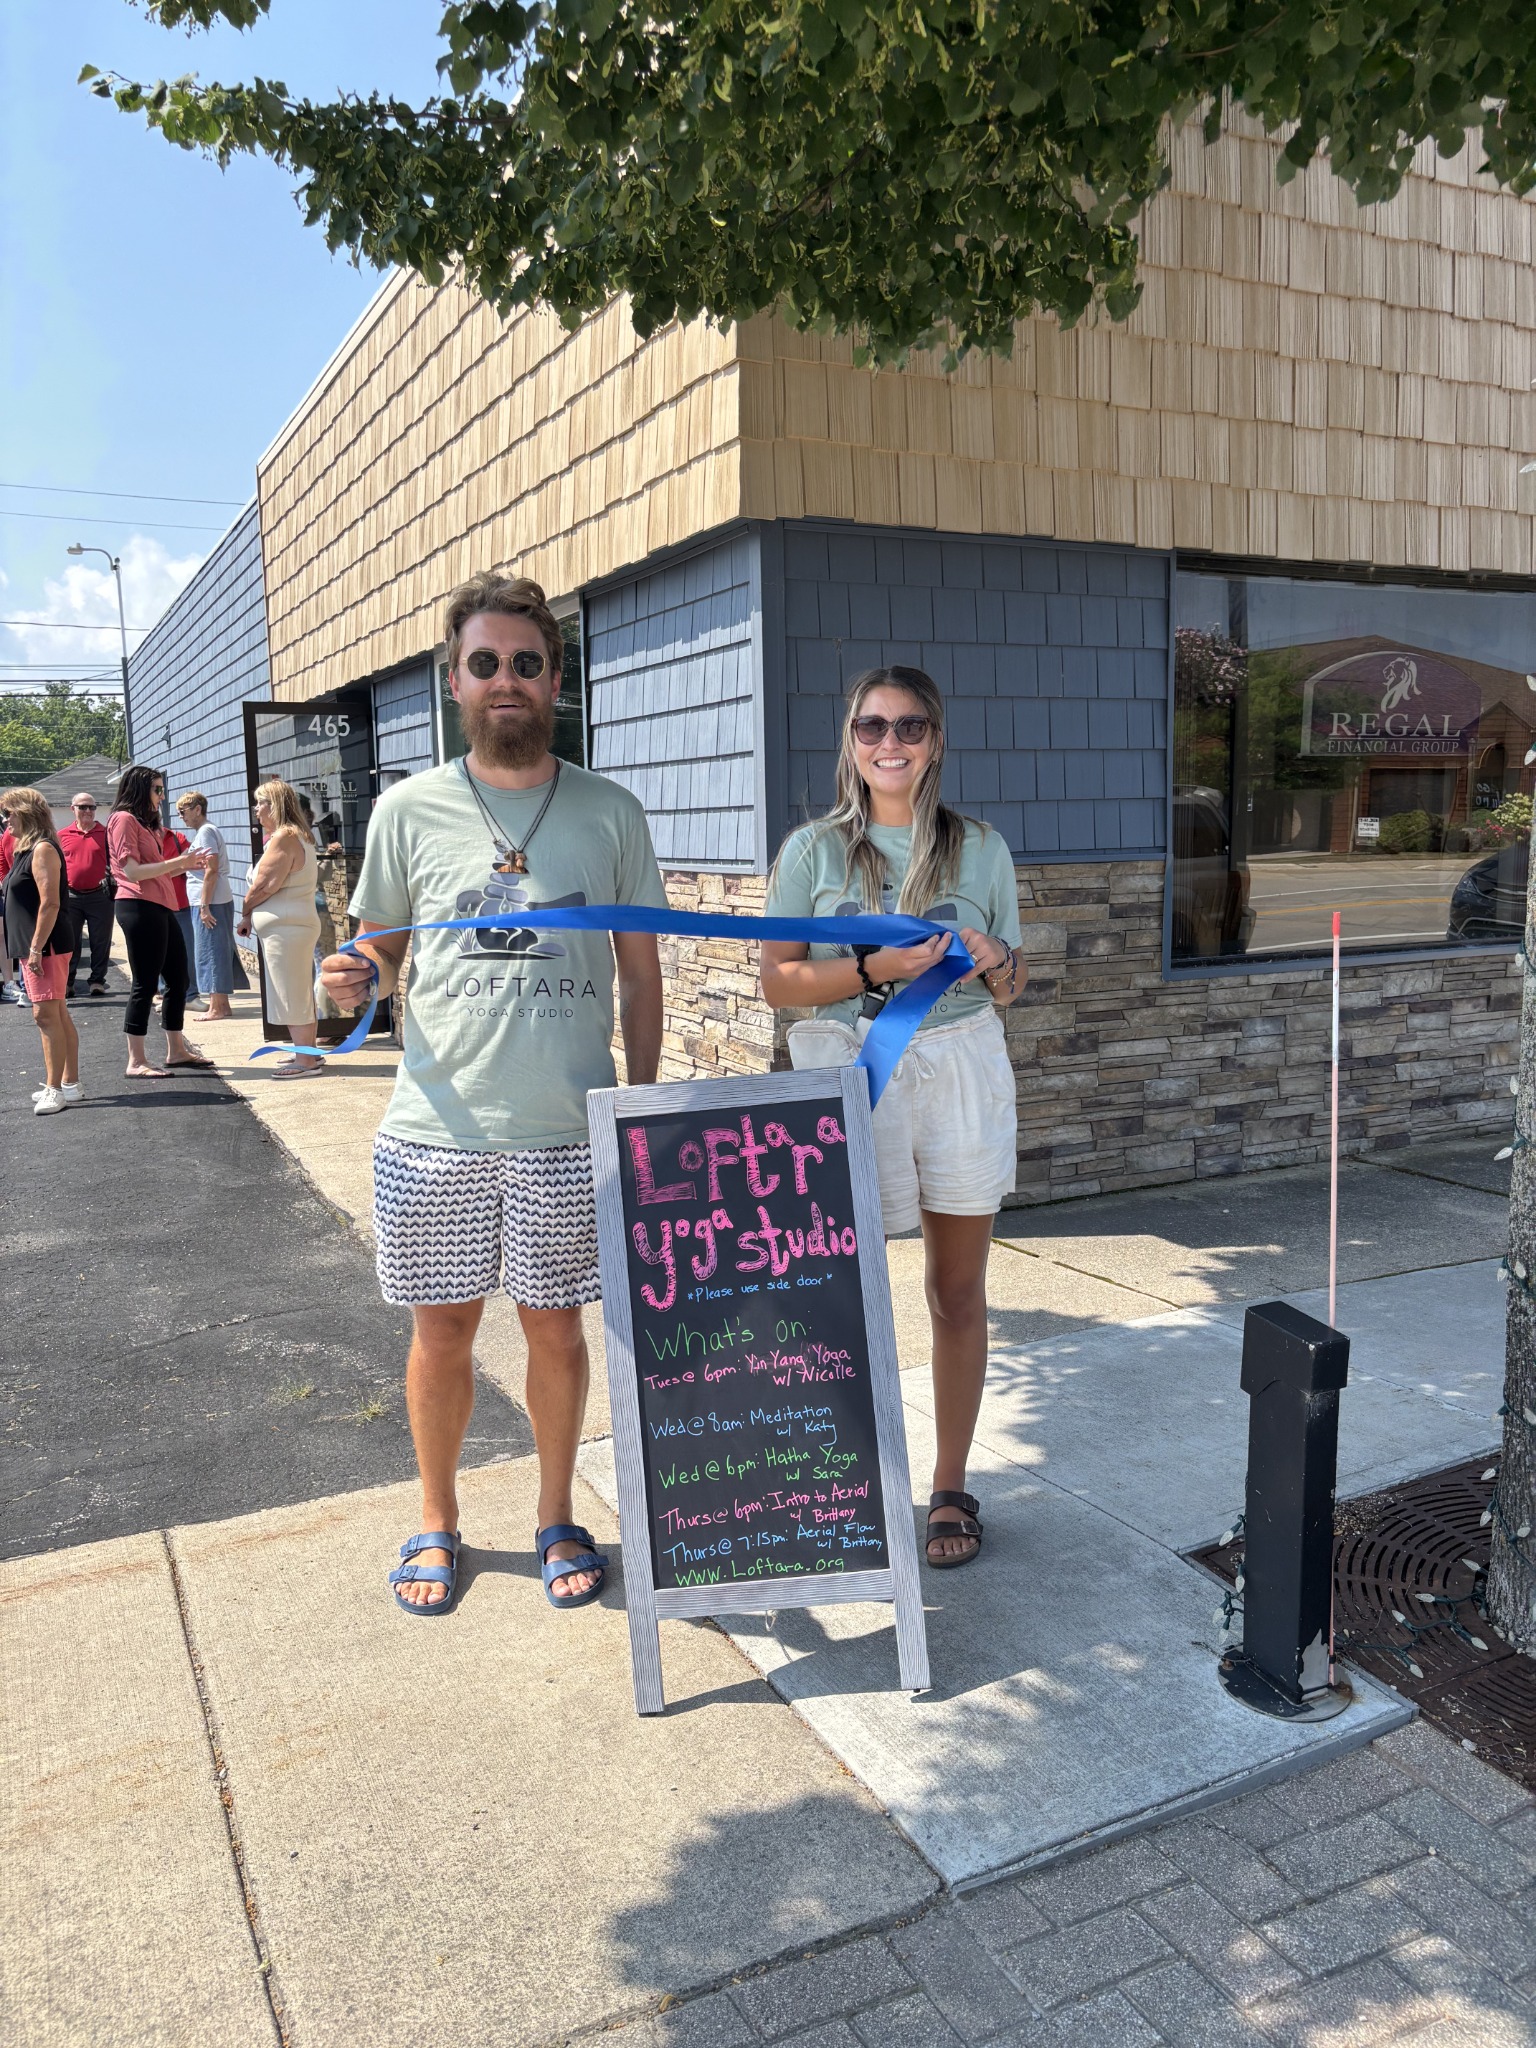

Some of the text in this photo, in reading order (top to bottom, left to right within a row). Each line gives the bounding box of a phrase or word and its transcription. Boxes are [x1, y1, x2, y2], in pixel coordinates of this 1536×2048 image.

[308, 714, 350, 737] 465
[1329, 712, 1461, 737] REGAL
[1328, 740, 1459, 753] FINANCIAL GROUP
[309, 781, 357, 792] REAL
[446, 977, 597, 998] LOFTARA
[467, 1008, 574, 1018] YOGA STUDIO
[735, 1201, 857, 1277] studio
[741, 1282, 760, 1294] use
[767, 1278, 791, 1291] side
[645, 1316, 754, 1360] What's
[745, 1354, 768, 1374] Yin
[770, 1349, 806, 1370] Yang
[813, 1343, 852, 1367] Yoga
[772, 1366, 856, 1387] w/ Nicolle
[750, 1405, 833, 1426] Meditation
[804, 1420, 838, 1447] Katy
[658, 1463, 700, 1489] Wed
[765, 1447, 811, 1468] Hatha
[819, 1445, 858, 1470] Yoga
[813, 1467, 844, 1480] Sara
[767, 1491, 810, 1511] Intro
[814, 1490, 828, 1503] to
[831, 1480, 869, 1503] Aerial
[813, 1507, 856, 1523] Brittany
[797, 1523, 836, 1541] Aerial
[844, 1522, 876, 1533] Flow
[839, 1536, 883, 1551] Brittany
